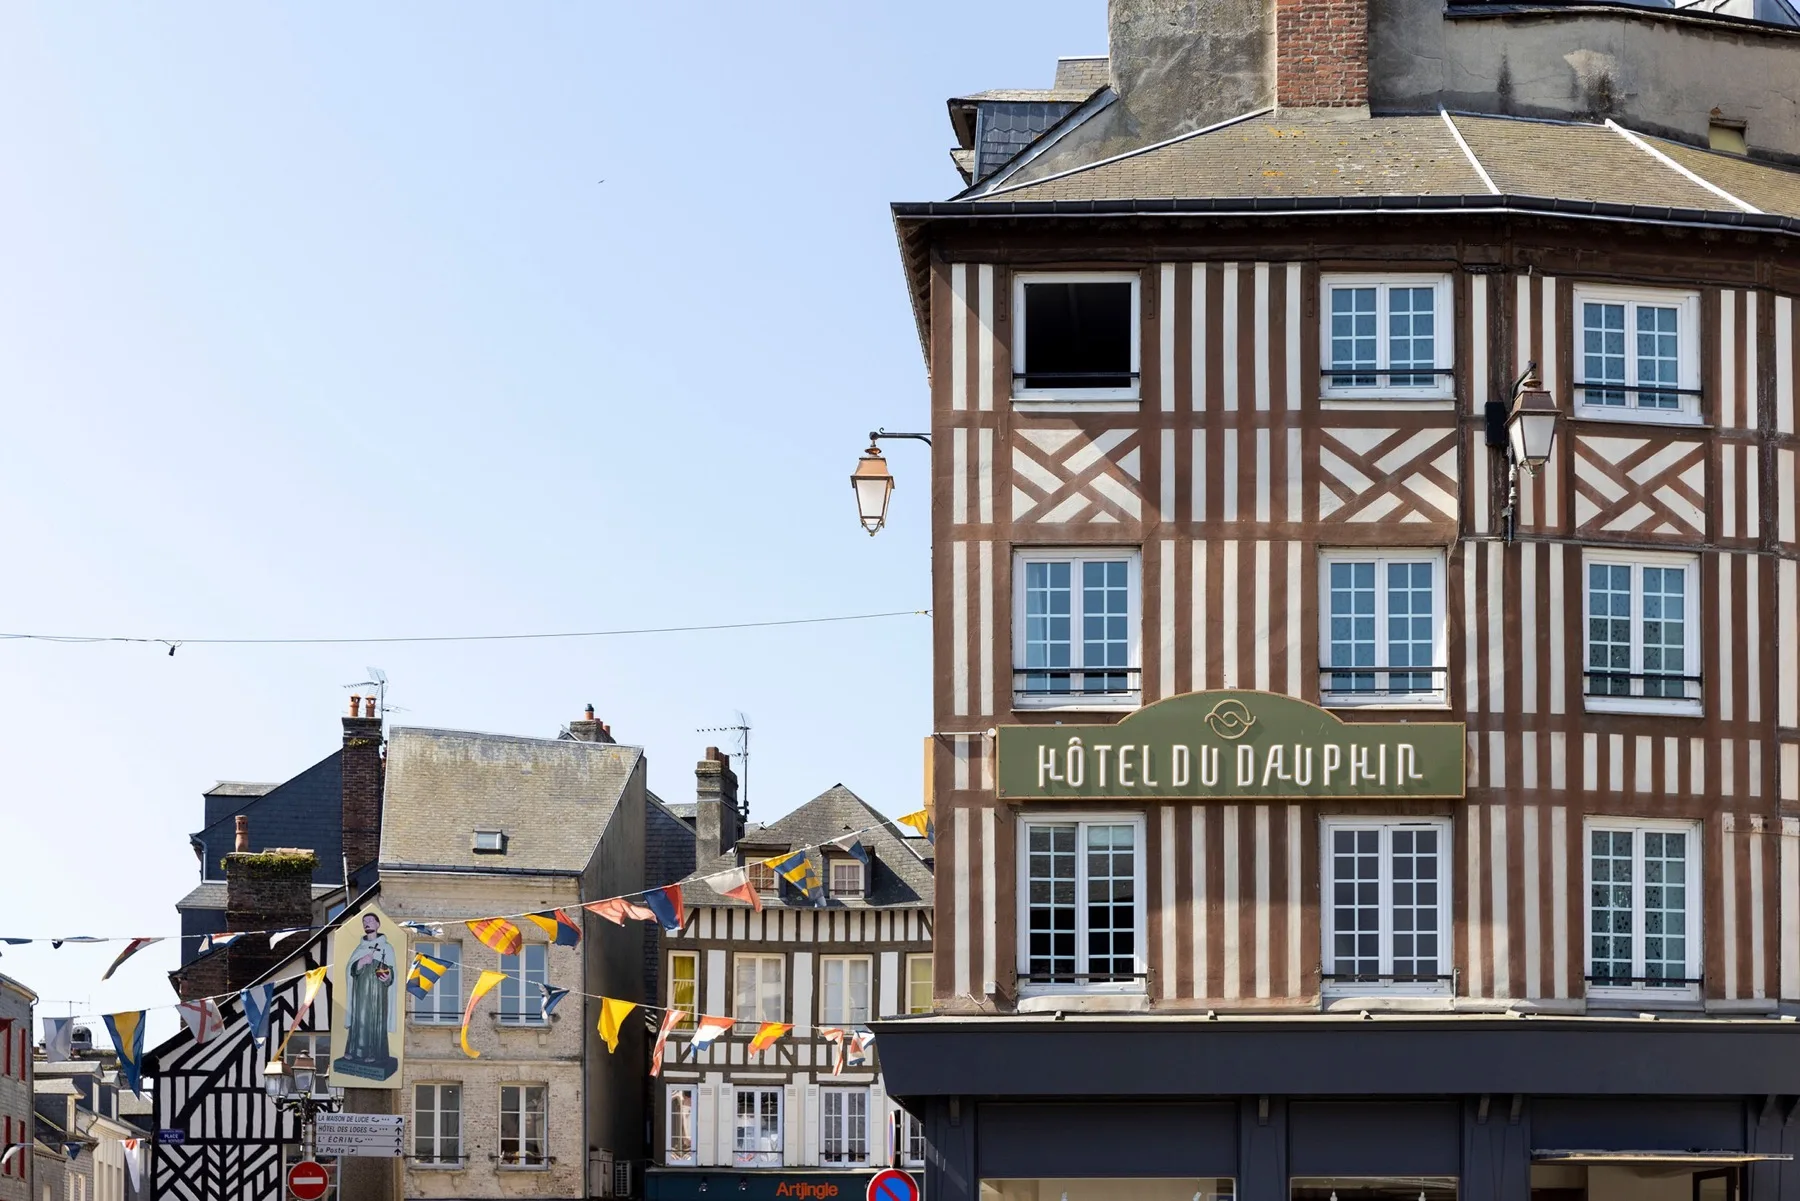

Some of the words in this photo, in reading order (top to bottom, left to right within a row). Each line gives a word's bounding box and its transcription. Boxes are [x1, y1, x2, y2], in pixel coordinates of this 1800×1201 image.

[1038, 736, 1158, 788] HÔTEL
[1172, 744, 1219, 788] DU
[1236, 743, 1424, 788] DAUPHIN
[318, 1124, 335, 1133] HÔTEL
[328, 1135, 354, 1143] ÉCRIN
[775, 1182, 839, 1200] Artjingle
